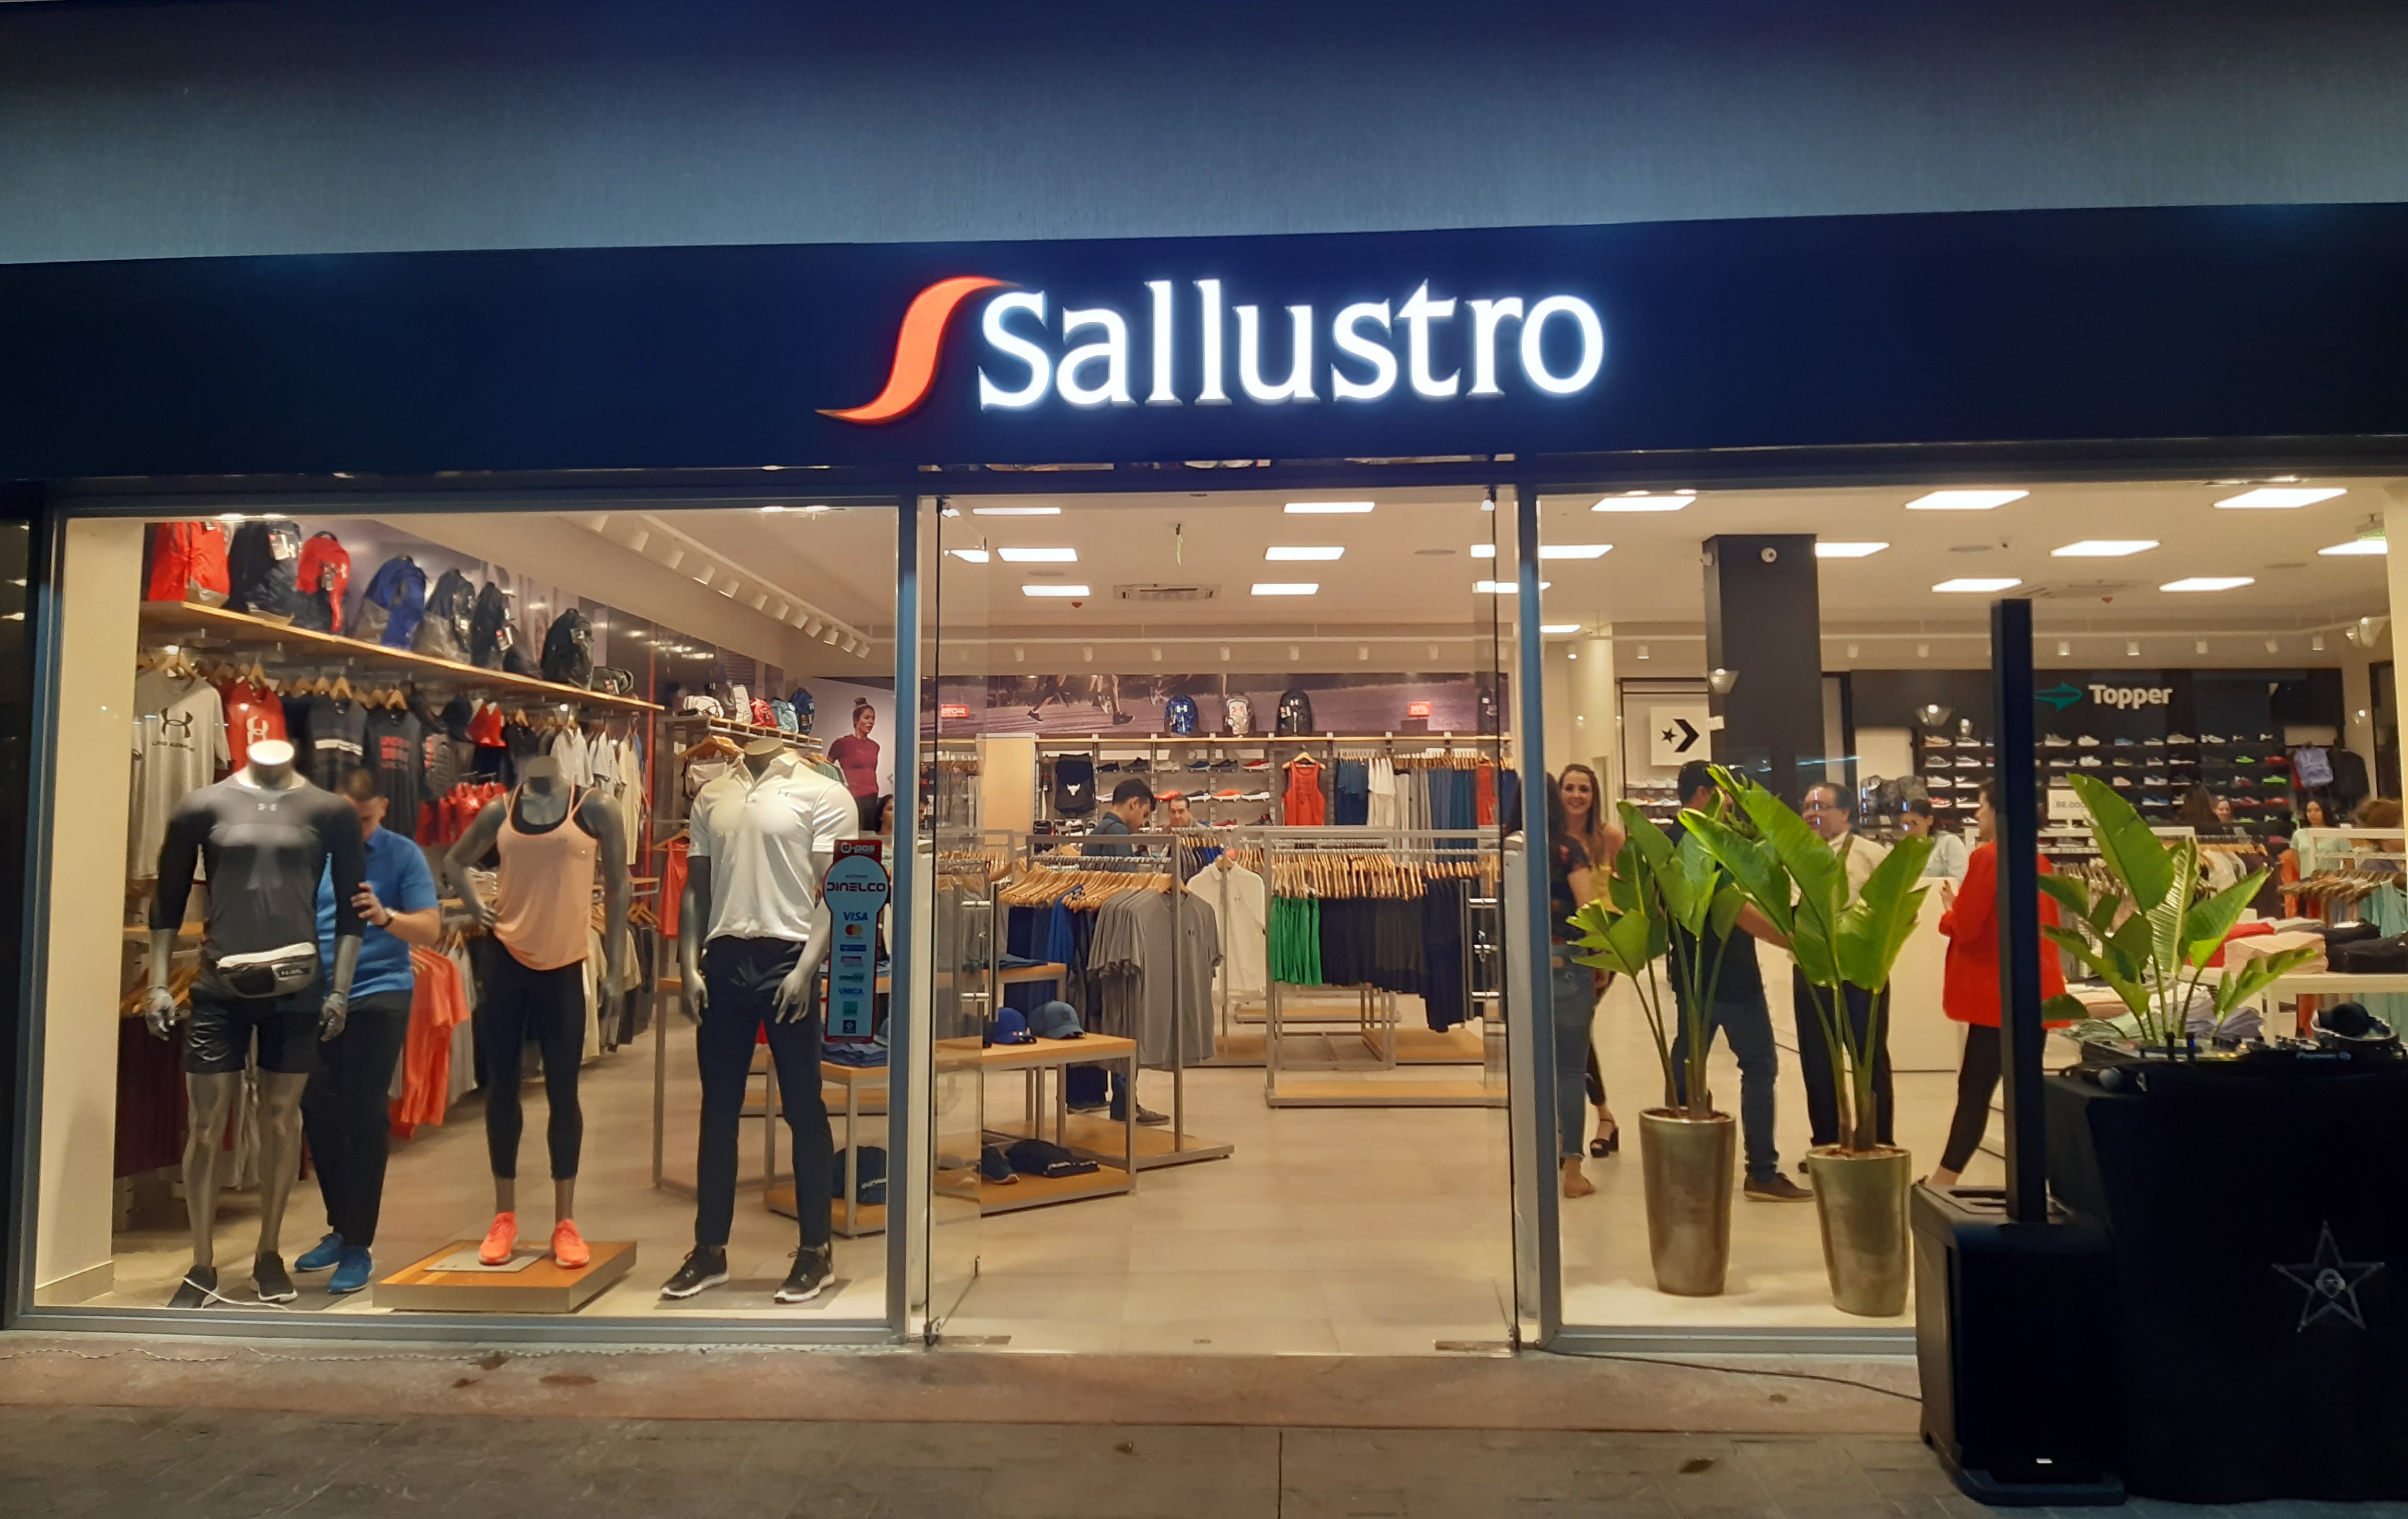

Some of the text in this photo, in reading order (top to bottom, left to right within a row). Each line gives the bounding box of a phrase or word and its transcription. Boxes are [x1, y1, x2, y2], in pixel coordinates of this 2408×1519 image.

[976, 279, 1605, 413] Sallustro
[2088, 683, 2174, 710] Topper
[826, 882, 886, 892] DINELCO
[842, 912, 869, 921] VISA
